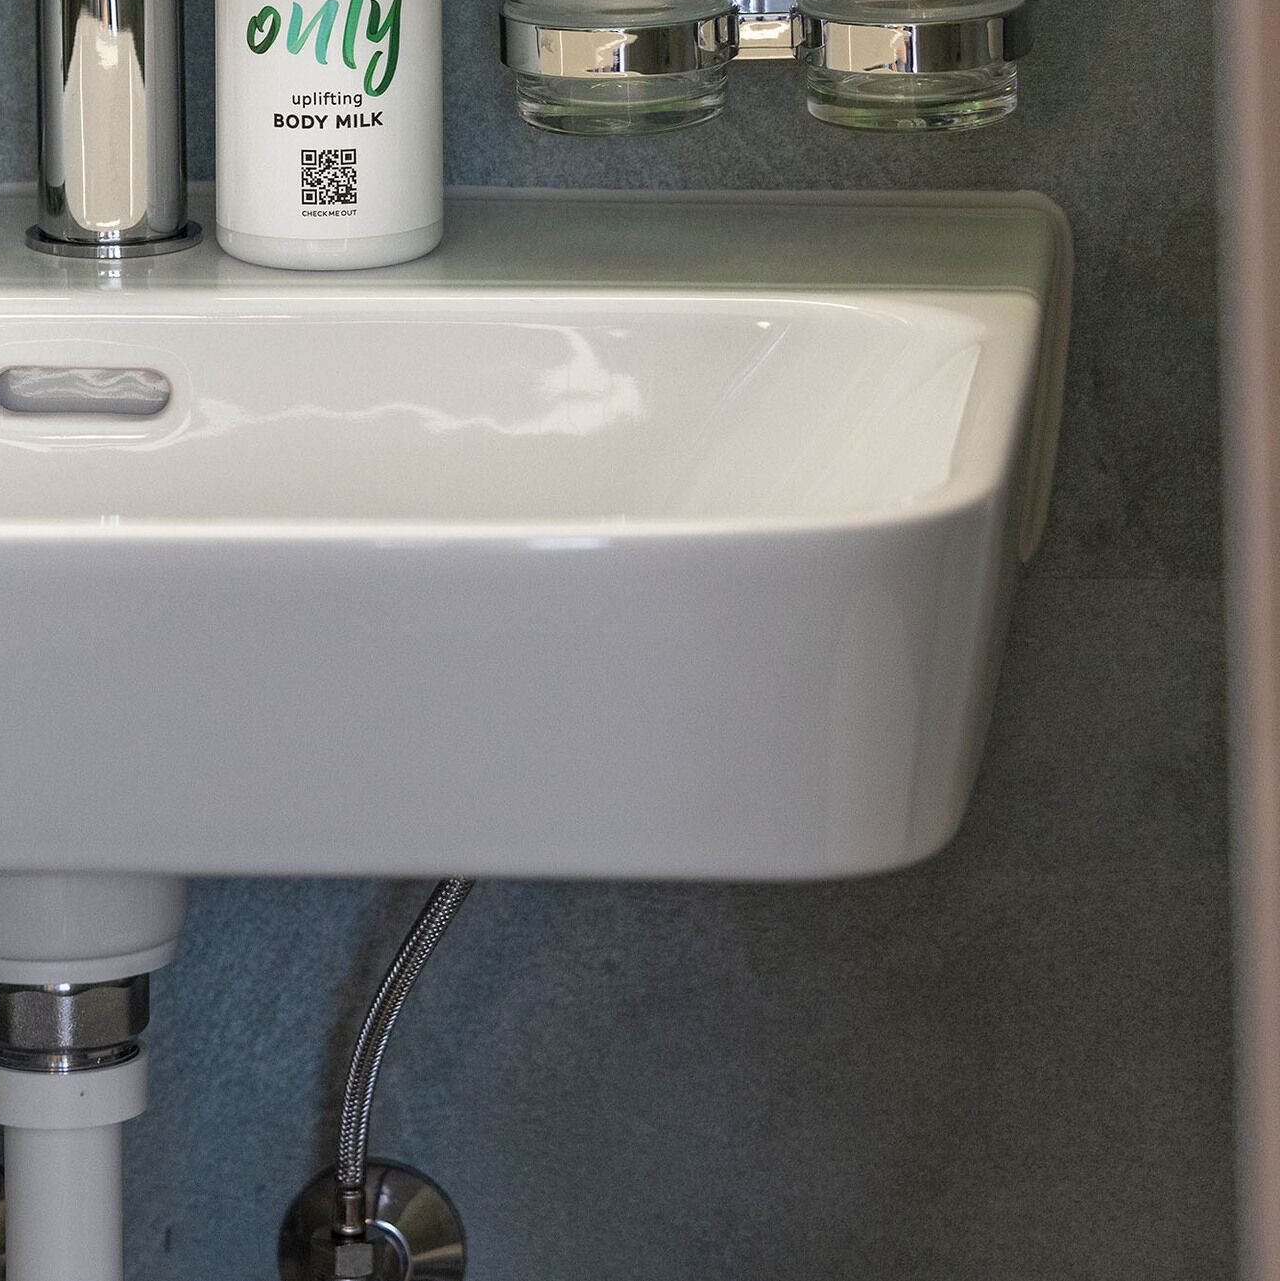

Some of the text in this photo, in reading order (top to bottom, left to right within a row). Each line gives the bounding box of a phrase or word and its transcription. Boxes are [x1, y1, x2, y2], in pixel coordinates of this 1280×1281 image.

[291, 91, 363, 108] uplifting
[273, 111, 384, 129] BODY MILK
[340, 209, 357, 217] OUT
